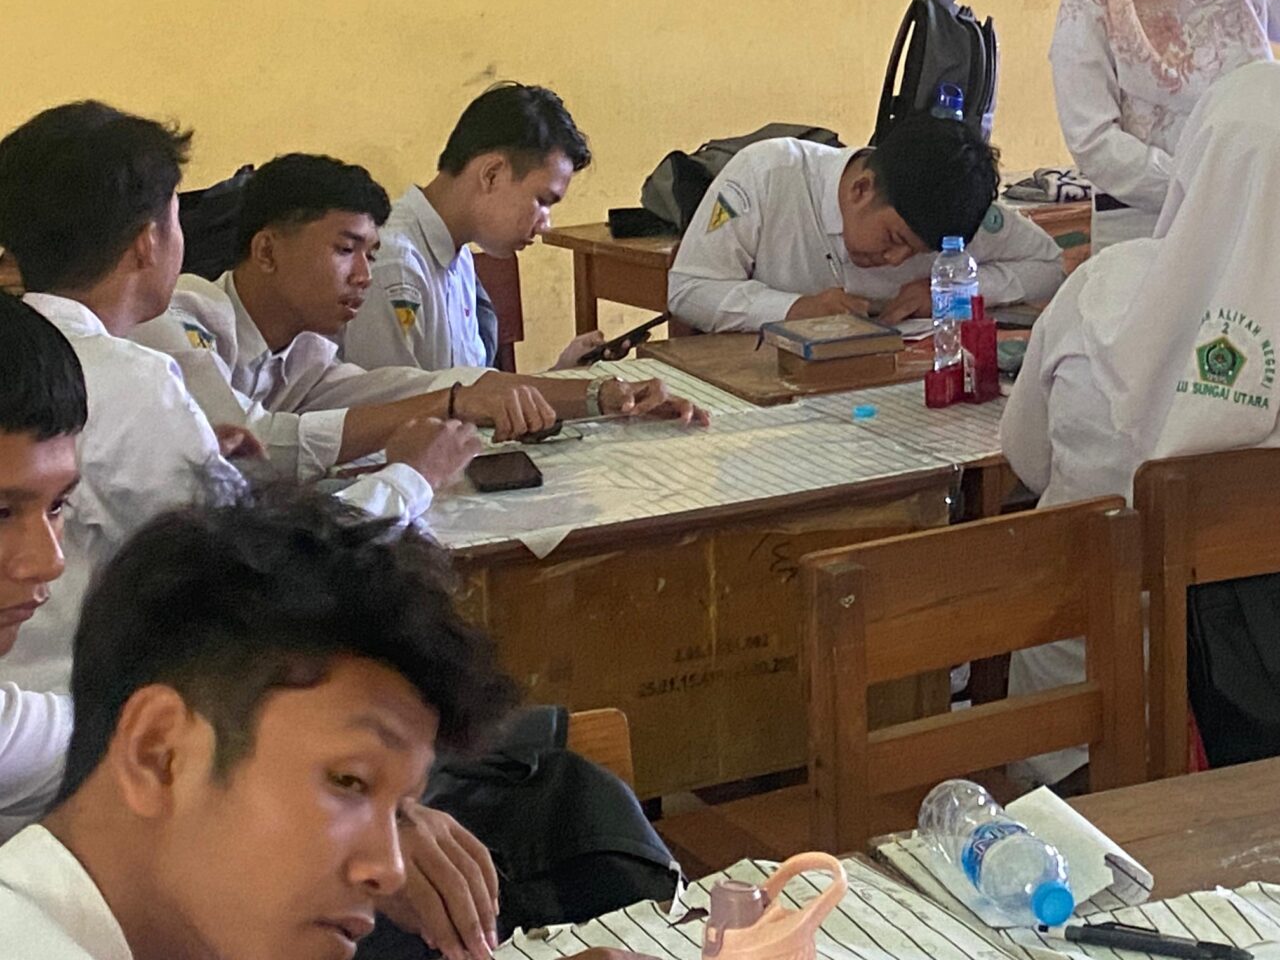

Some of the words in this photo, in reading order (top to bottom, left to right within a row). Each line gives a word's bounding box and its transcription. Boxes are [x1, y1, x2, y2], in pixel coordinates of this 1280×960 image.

[1218, 308, 1261, 336] ALIYAH
[1222, 322, 1229, 334] 2
[1192, 382, 1230, 400] SUNGAI
[1233, 391, 1269, 410] UTARA
